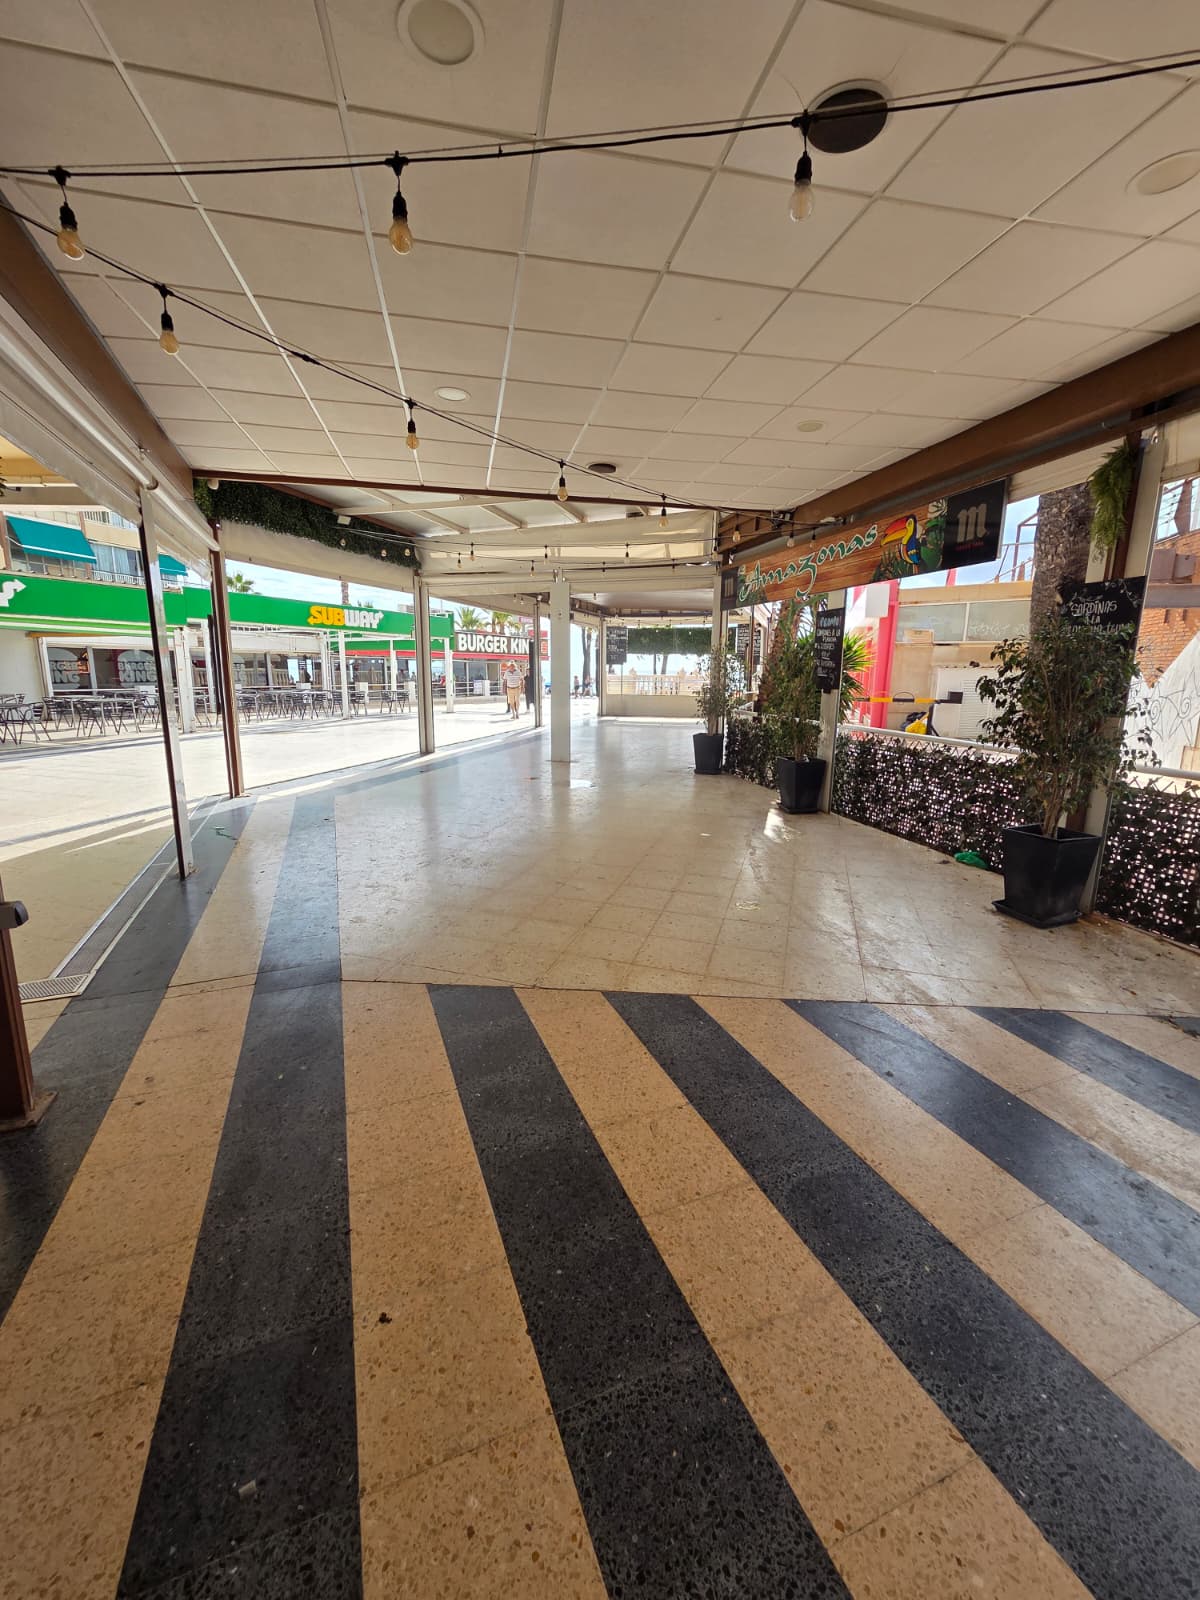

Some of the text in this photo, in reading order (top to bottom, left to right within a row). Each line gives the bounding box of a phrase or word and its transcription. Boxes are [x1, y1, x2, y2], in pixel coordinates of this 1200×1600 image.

[738, 524, 878, 602] Amazonas
[307, 605, 384, 630] SUBWAY
[1070, 600, 1118, 617] SARDINAS
[458, 633, 508, 653] BURGER
[510, 638, 530, 655] KIN
[50, 670, 81, 683] ING
